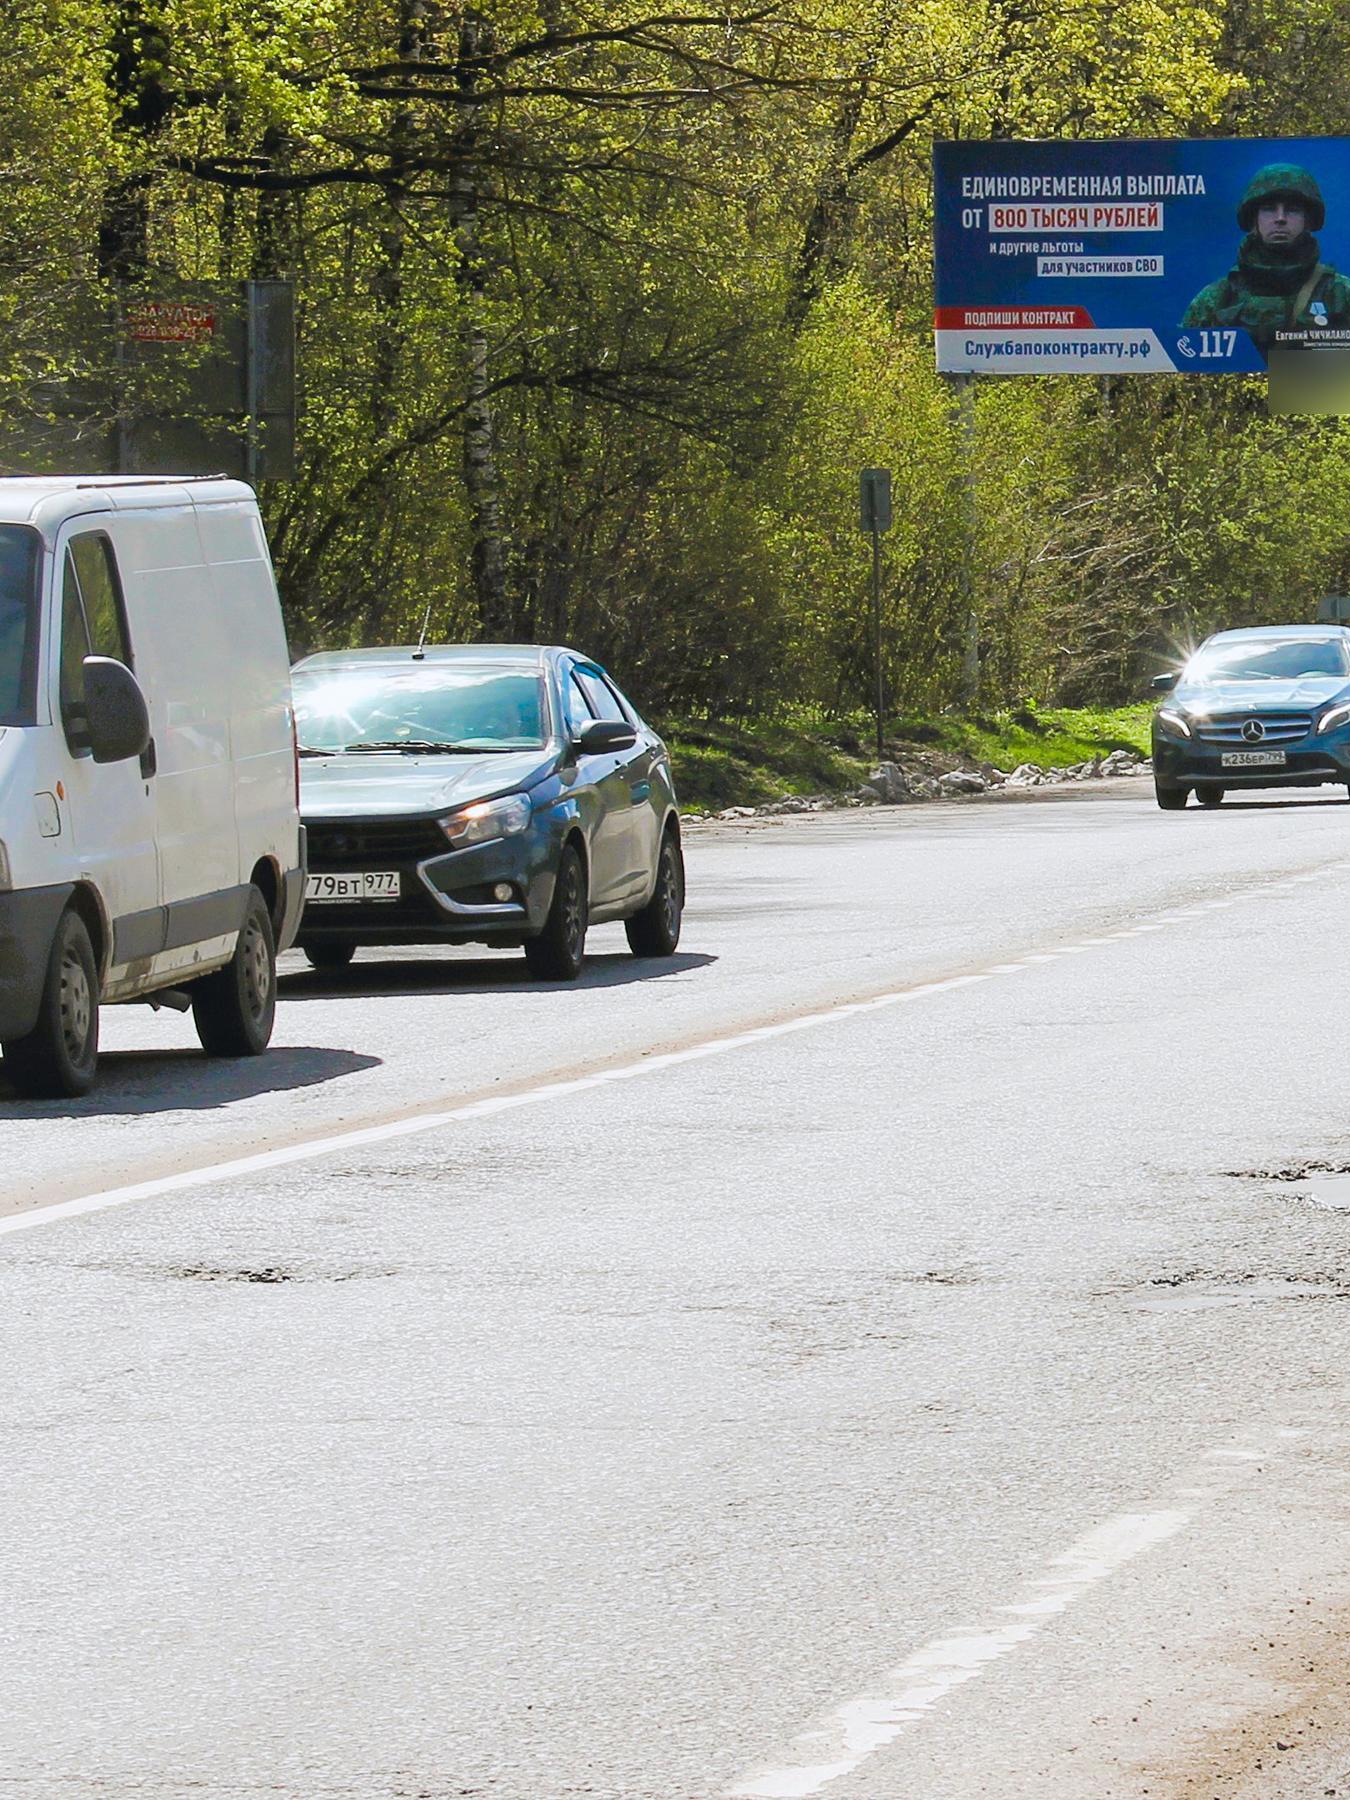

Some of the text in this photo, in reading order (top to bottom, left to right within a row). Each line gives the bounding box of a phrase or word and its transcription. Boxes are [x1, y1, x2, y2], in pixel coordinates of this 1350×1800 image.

[962, 175, 1206, 199] ЕДИНОВРЕМЕННАЯ ВЫПЛАТА
[962, 202, 1158, 229] ОТ 800 ТЫСЯЧ РУБЛЕЙ
[989, 242, 1084, 256] и другие льготы
[1042, 259, 1157, 275] для участников СВО
[964, 311, 1076, 326] ПОДПИШИ КОНТРАКТ
[1200, 330, 1237, 358] 117
[1275, 330, 1308, 341] Евгений
[965, 339, 1151, 358] Службапоконтракту.рф
[307, 874, 394, 896] 79ВТ 977
